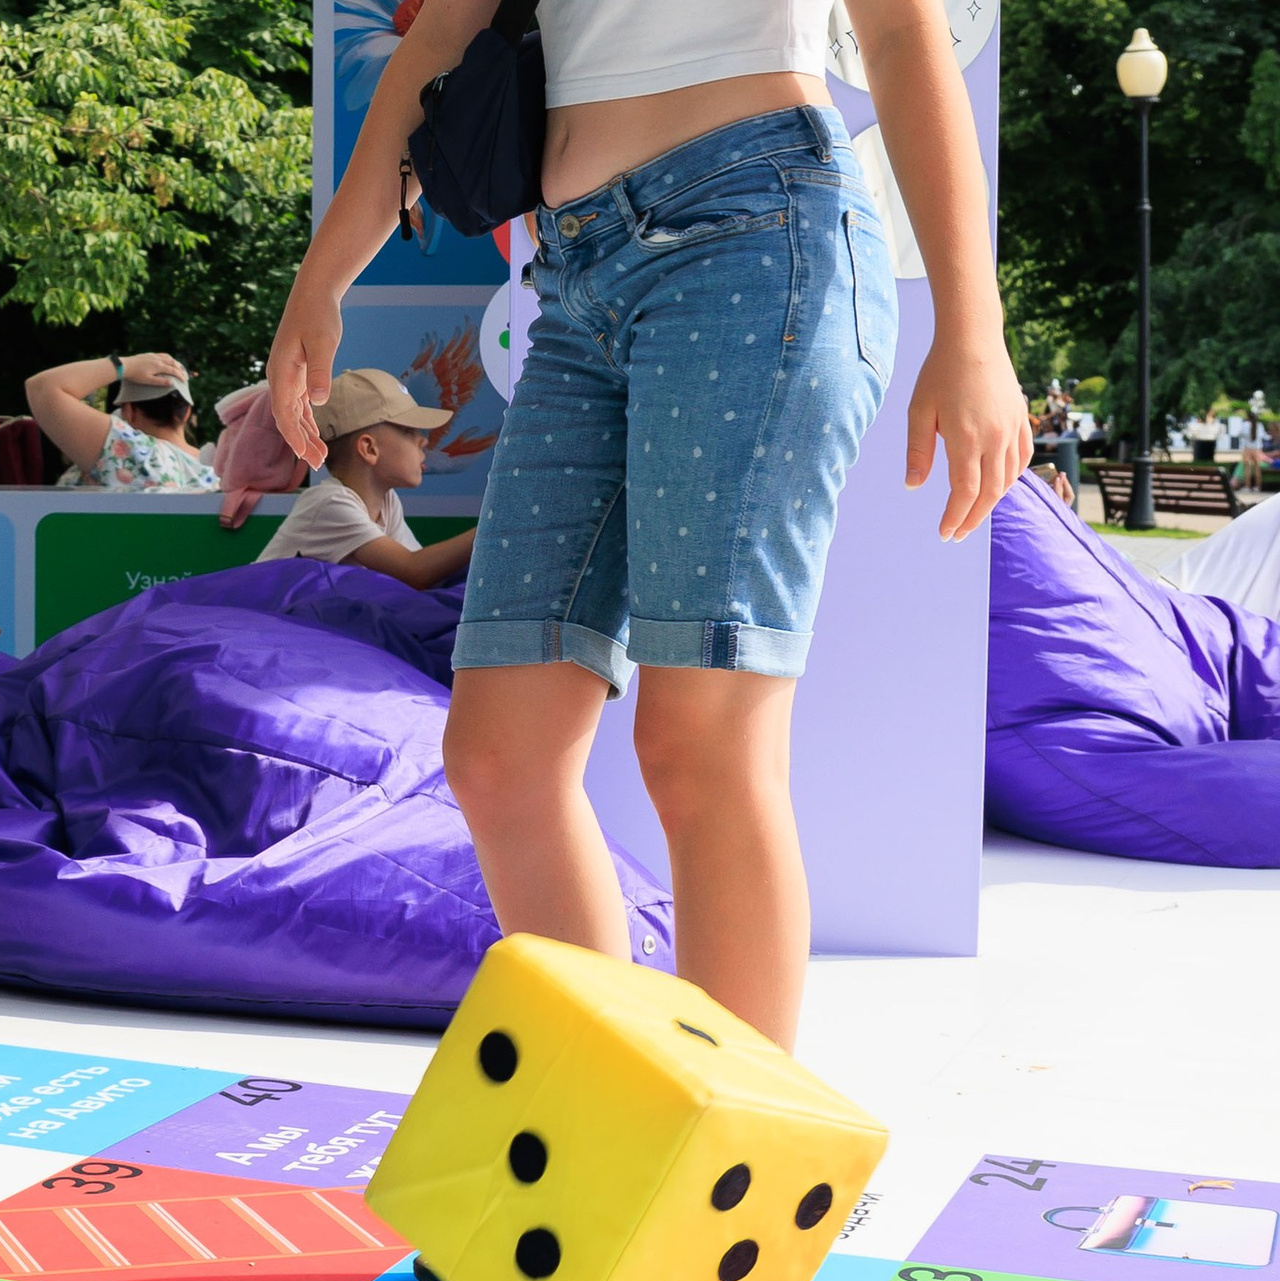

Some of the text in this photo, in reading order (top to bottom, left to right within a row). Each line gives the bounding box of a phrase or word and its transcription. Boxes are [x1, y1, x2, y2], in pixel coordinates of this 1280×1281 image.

[31, 1065, 111, 1096] есть
[219, 1079, 303, 1106] 40
[8, 1077, 152, 1140] на Авито
[215, 1126, 309, 1166] А мы
[282, 1136, 366, 1171] тебя
[344, 1110, 404, 1135] тут
[42, 1162, 143, 1194] 39
[969, 1158, 1057, 1191] 24
